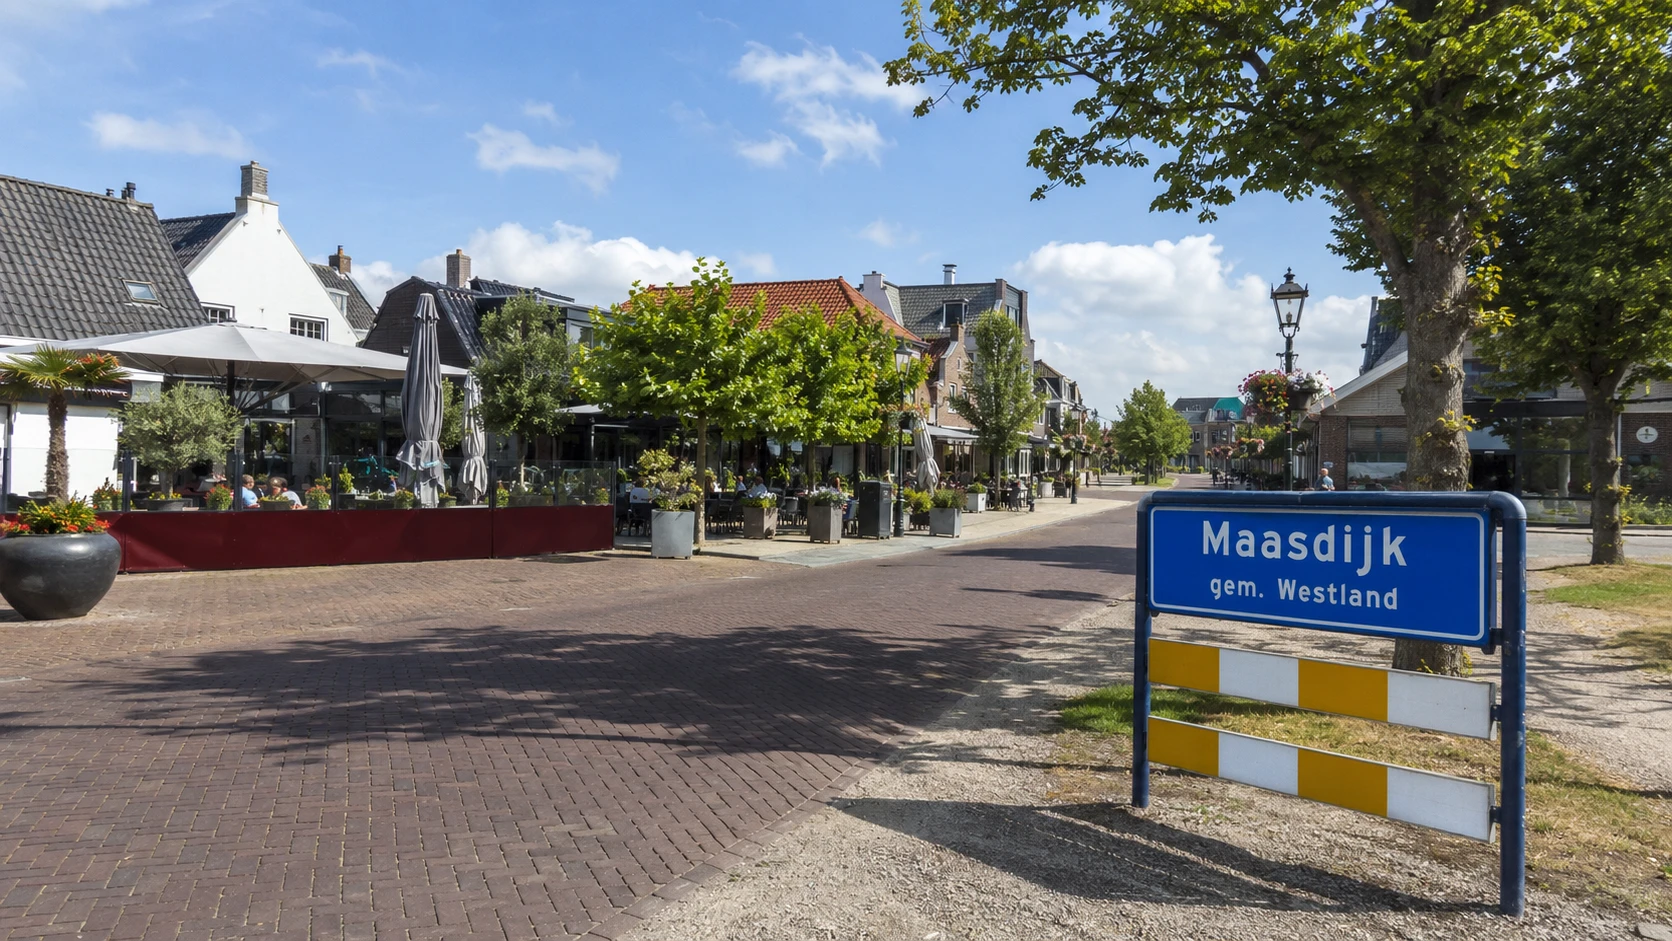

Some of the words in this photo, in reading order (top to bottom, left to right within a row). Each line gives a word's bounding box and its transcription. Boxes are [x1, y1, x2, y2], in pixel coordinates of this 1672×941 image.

[1202, 520, 1407, 577] Maasdijk
[1210, 577, 1264, 600] gem.
[1277, 578, 1398, 610] Westland
